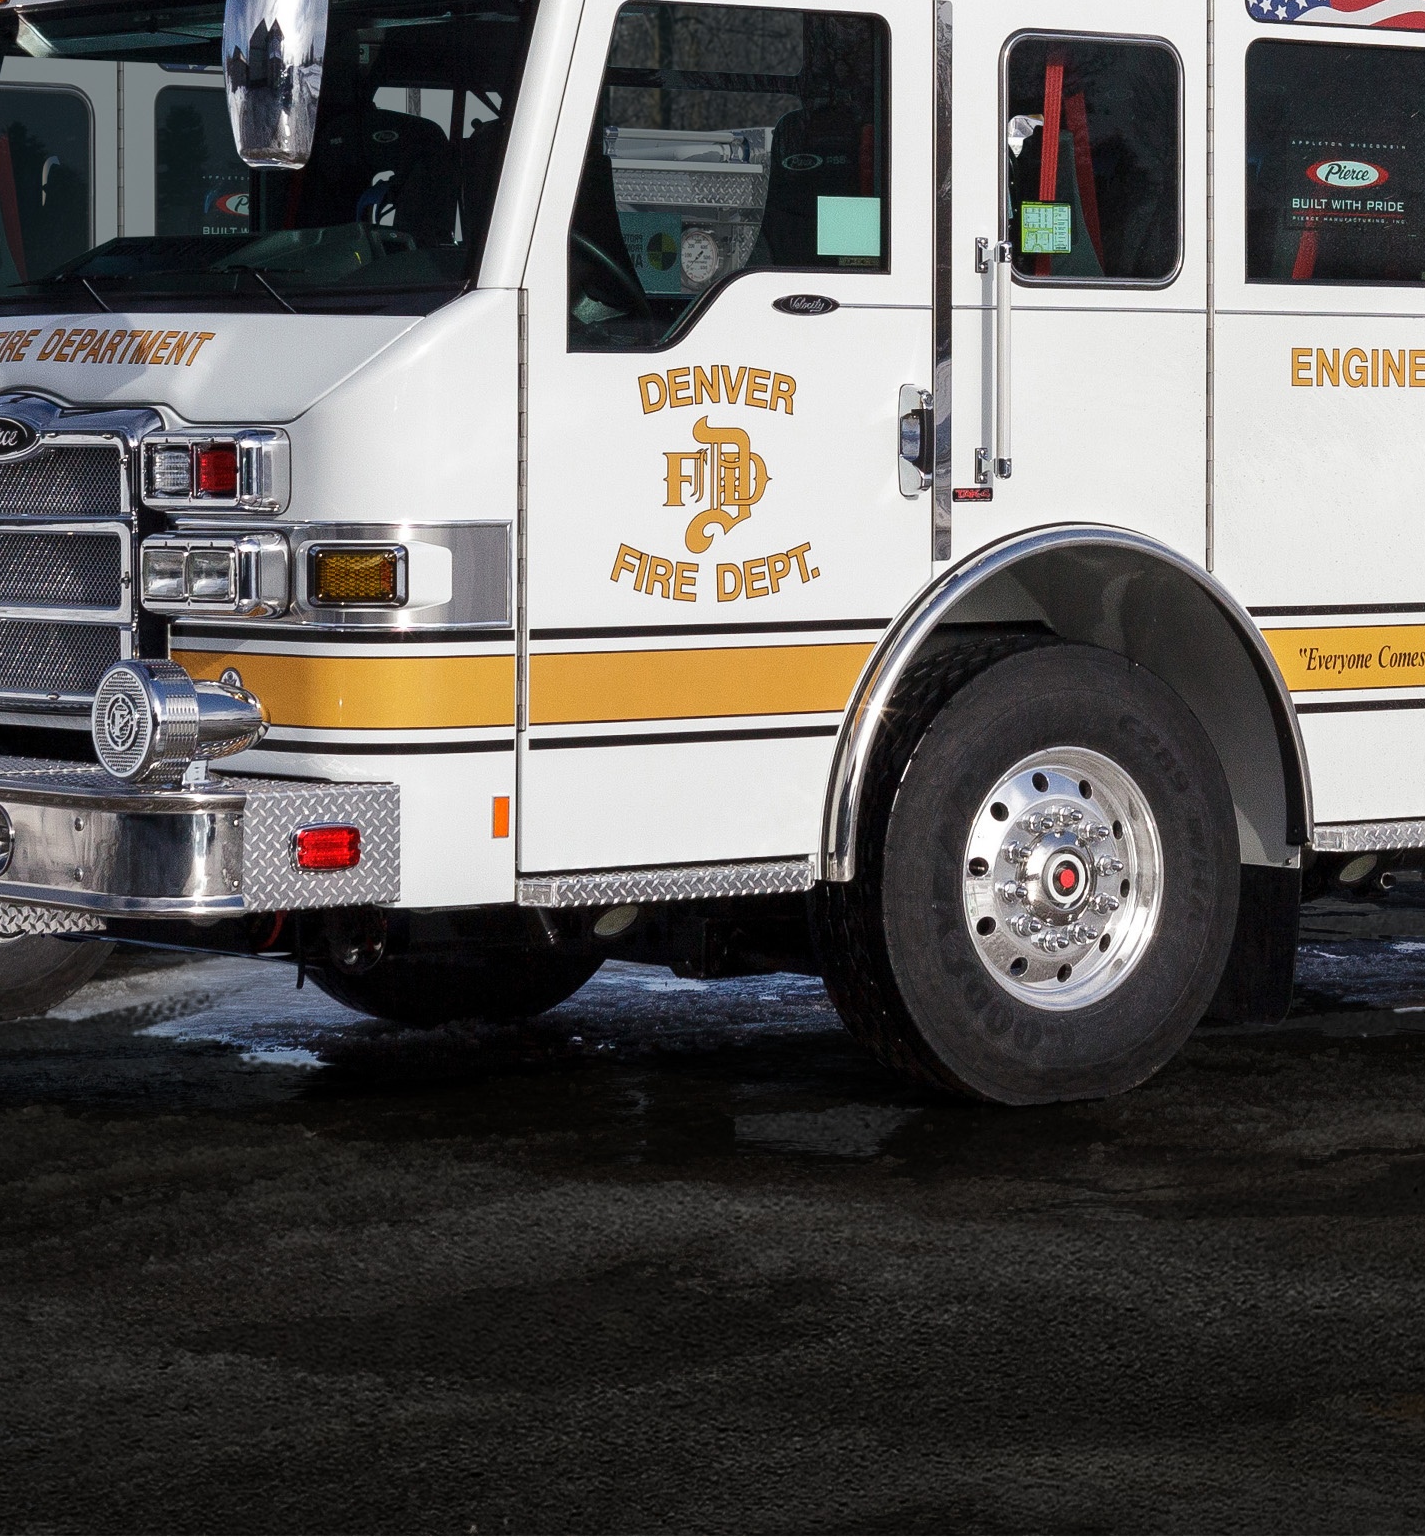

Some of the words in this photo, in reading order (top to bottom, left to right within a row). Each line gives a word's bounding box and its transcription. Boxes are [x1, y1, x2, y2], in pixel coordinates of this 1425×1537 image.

[1325, 163, 1369, 182] Pierce
[1292, 198, 1328, 209] BUILT
[1332, 199, 1362, 210] WITH
[1366, 201, 1405, 212] PRIDE
[202, 226, 237, 235] BUILT
[790, 297, 824, 312] Velocity
[37, 329, 216, 367] DEPARTMENT
[638, 364, 797, 415] DENVER
[610, 543, 699, 602] FIRE
[716, 541, 821, 602] DEPT.
[1298, 646, 1372, 674] "Everyone
[1378, 645, 1425, 668] Comes
